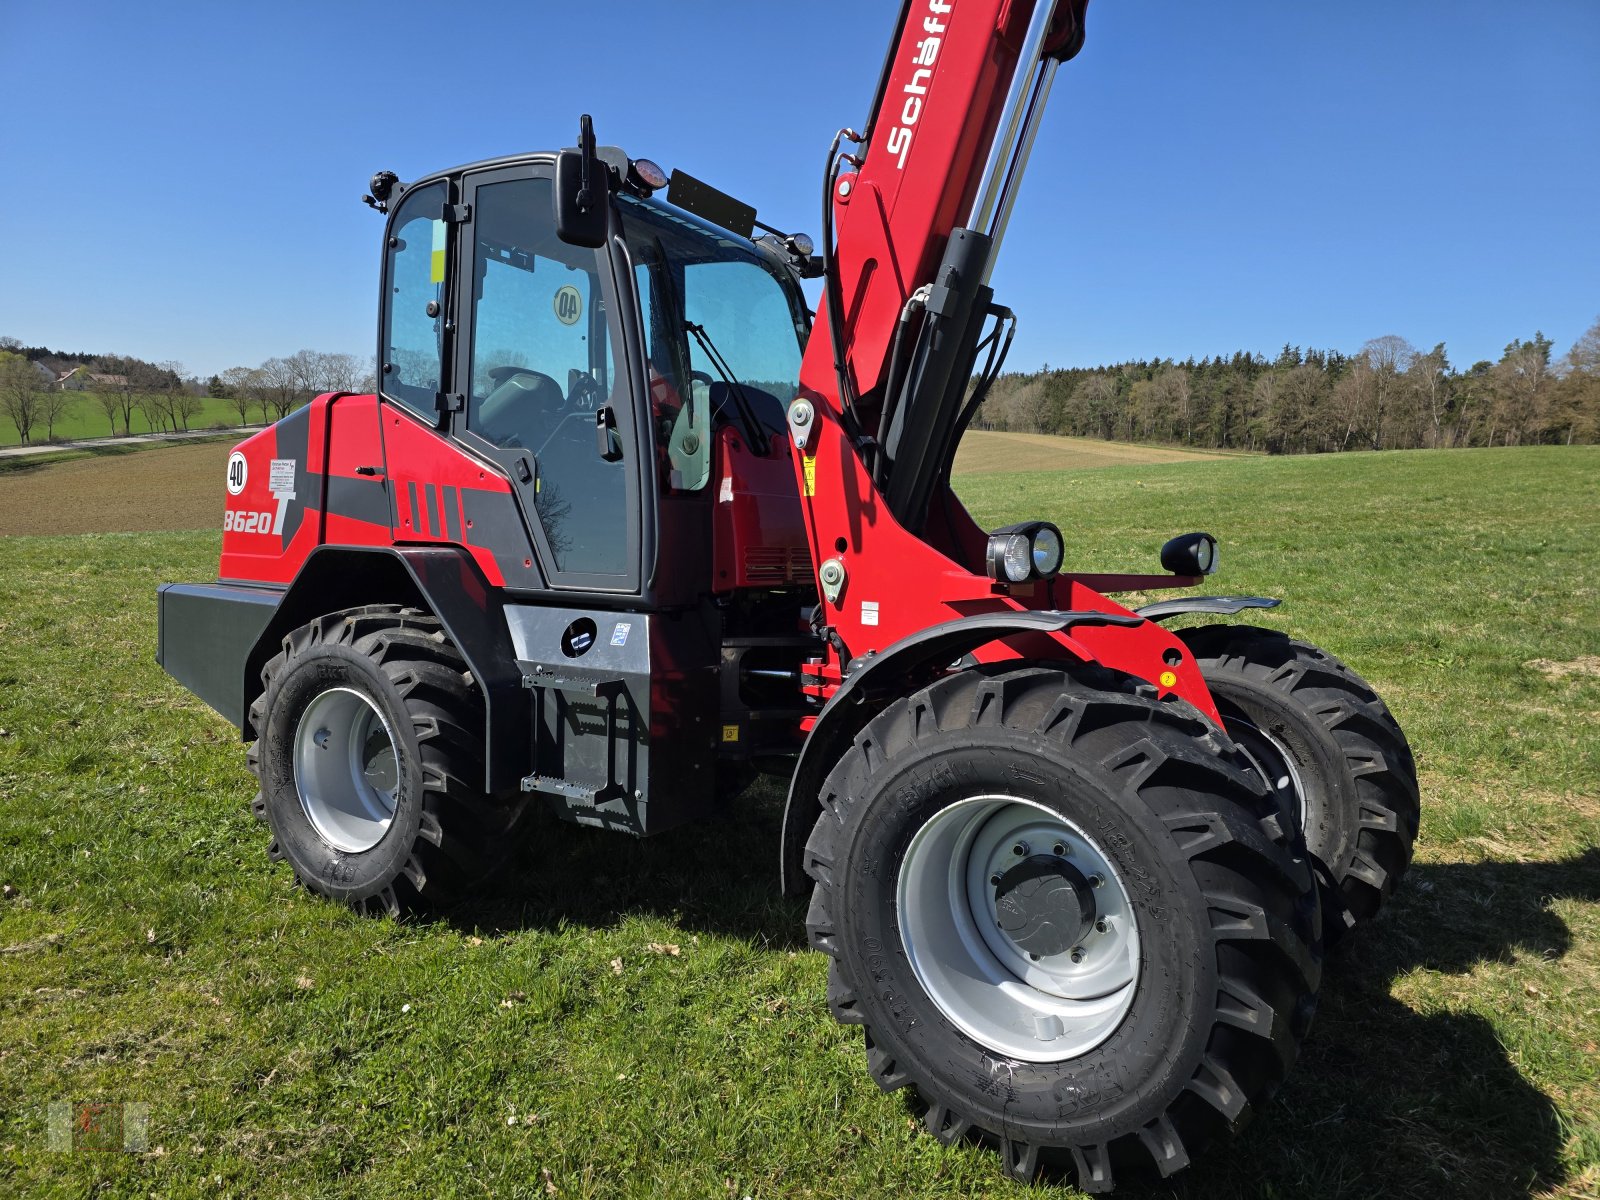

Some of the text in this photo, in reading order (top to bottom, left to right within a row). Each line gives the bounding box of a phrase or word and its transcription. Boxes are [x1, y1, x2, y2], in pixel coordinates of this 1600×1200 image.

[230, 461, 243, 486] 40
[224, 491, 296, 536] 8620 T
